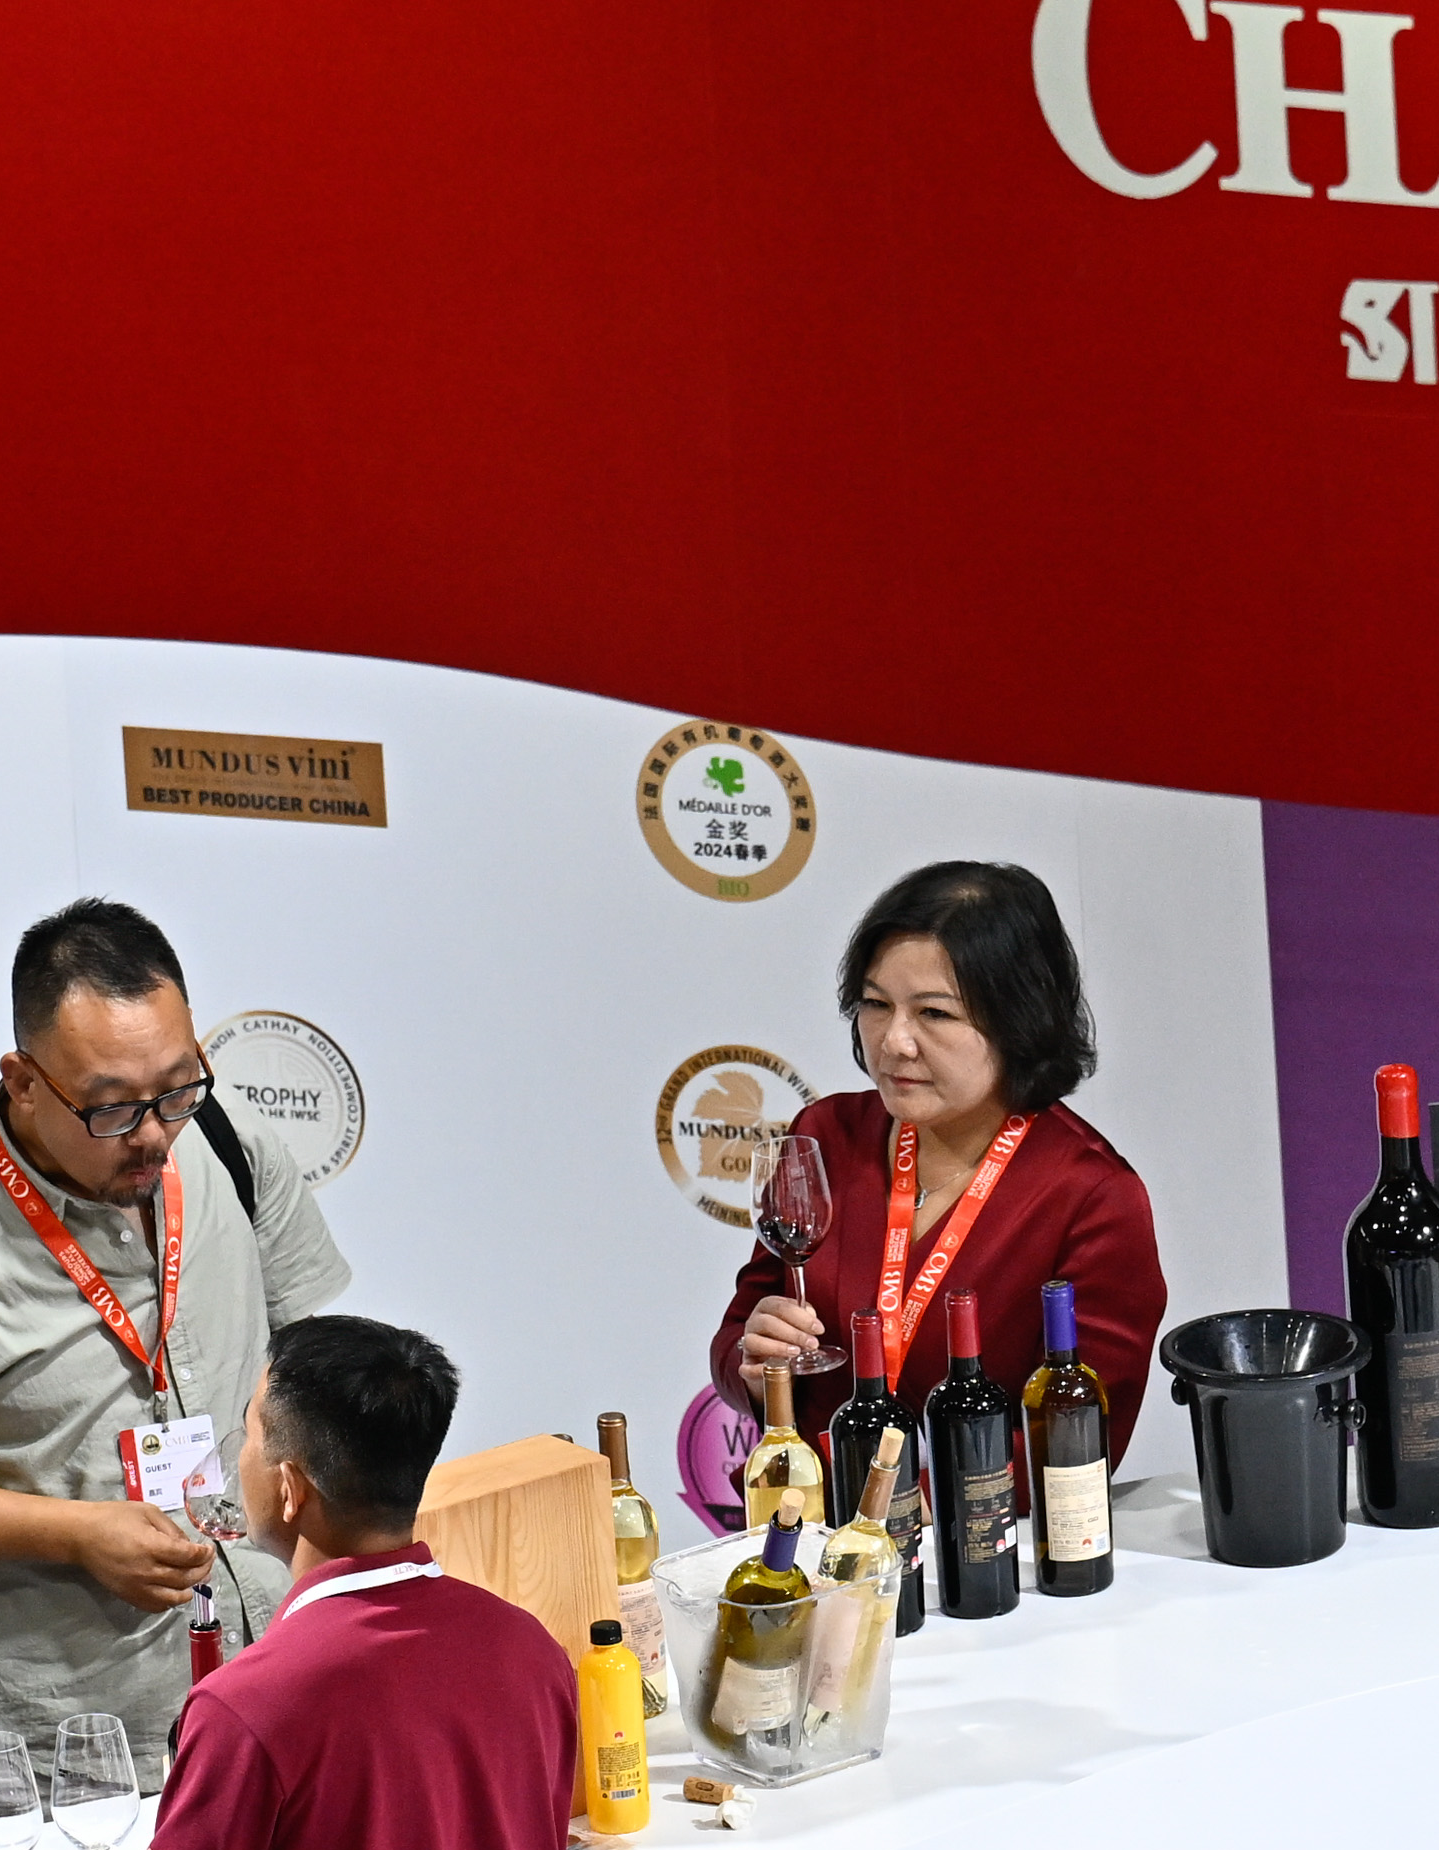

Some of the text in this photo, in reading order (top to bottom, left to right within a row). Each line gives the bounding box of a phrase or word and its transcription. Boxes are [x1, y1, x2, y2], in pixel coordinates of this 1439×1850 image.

[152, 747, 352, 781] MUNDUS vini
[142, 785, 371, 818] BEST PRODUCER CHINA
[678, 797, 739, 816] MÉDAILLE
[705, 818, 749, 841] 金奖
[242, 1020, 301, 1036] CATHAY
[679, 1121, 763, 1142] MUNDUS
[994, 1114, 1026, 1154] CMB
[897, 1131, 914, 1172] CMB
[166, 1236, 180, 1281] CMB
[915, 1252, 948, 1293] CMB
[92, 1287, 124, 1327] CMB
[880, 1270, 901, 1312] CMB
[145, 1463, 172, 1473] GUEST
